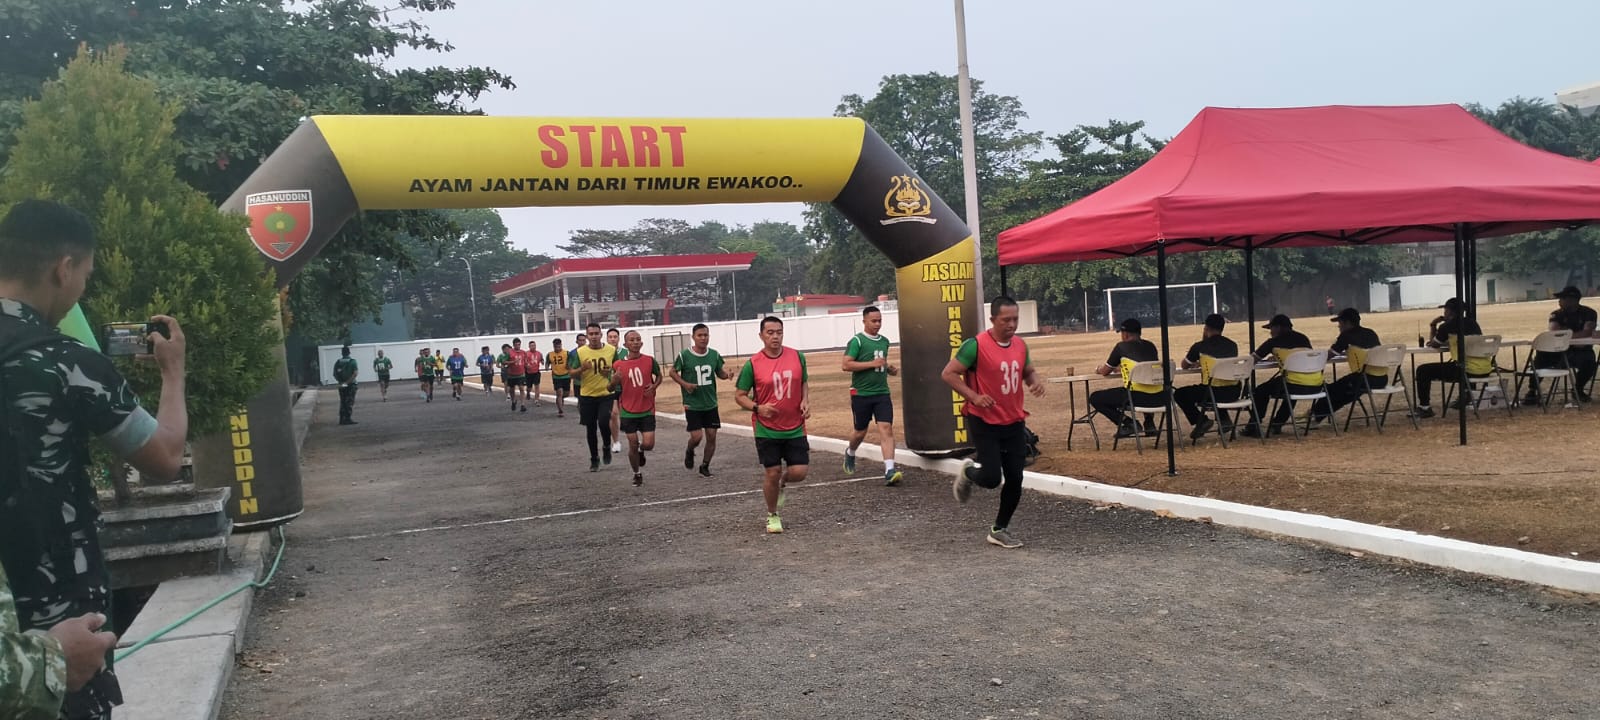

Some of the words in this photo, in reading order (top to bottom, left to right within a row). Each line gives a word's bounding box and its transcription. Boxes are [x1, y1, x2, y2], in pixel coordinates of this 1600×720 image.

[539, 124, 687, 169] START
[409, 178, 473, 193] AYAM
[480, 177, 570, 193] JANTAN
[577, 177, 627, 192] DARI
[633, 177, 701, 191] TIMUR
[707, 176, 803, 190] EWAKOO..
[248, 193, 308, 204] HASANUDDIN
[941, 284, 966, 303] XIV
[553, 355, 564, 365] 12
[591, 357, 607, 375] 10
[628, 367, 643, 388] 10
[694, 364, 712, 386] 12
[1000, 360, 1020, 395] 36
[772, 370, 793, 401] 07
